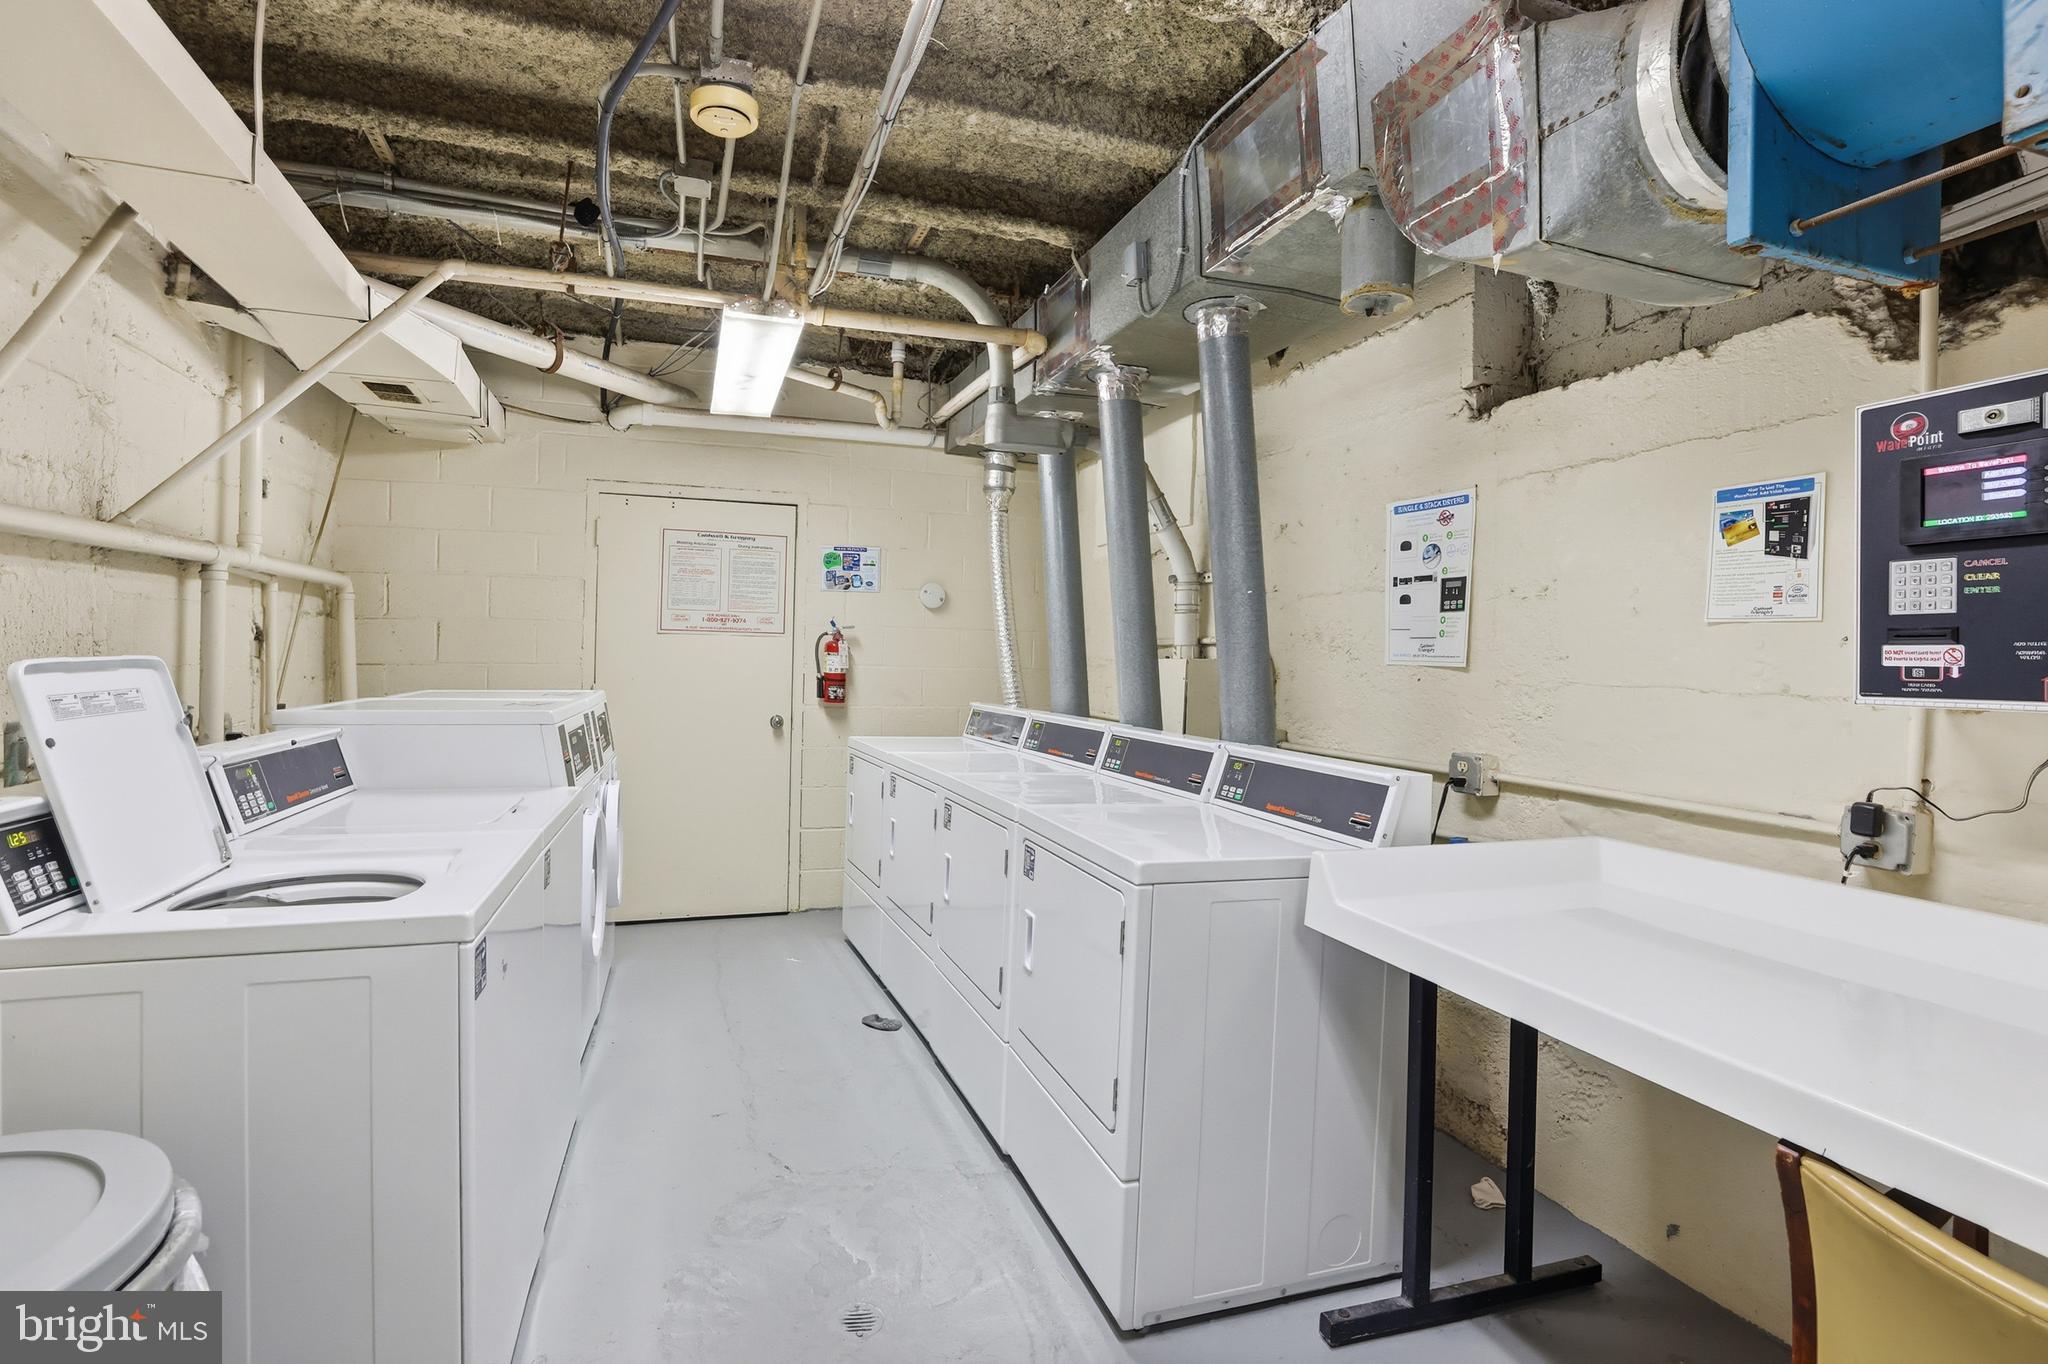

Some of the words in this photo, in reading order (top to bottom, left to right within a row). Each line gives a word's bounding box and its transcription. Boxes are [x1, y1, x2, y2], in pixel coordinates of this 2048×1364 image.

[1875, 430, 1944, 453] WavePoint
[1938, 465, 1965, 473] Welcome
[1397, 503, 1418, 513] SINGLE
[1423, 500, 1442, 510] STACK
[1442, 496, 1465, 507] DRYERS
[1938, 515, 1975, 526] LOCATION
[1963, 557, 2009, 568] CANCEL
[1963, 571, 2001, 582] CLEAR
[1963, 585, 2001, 595] ENTER
